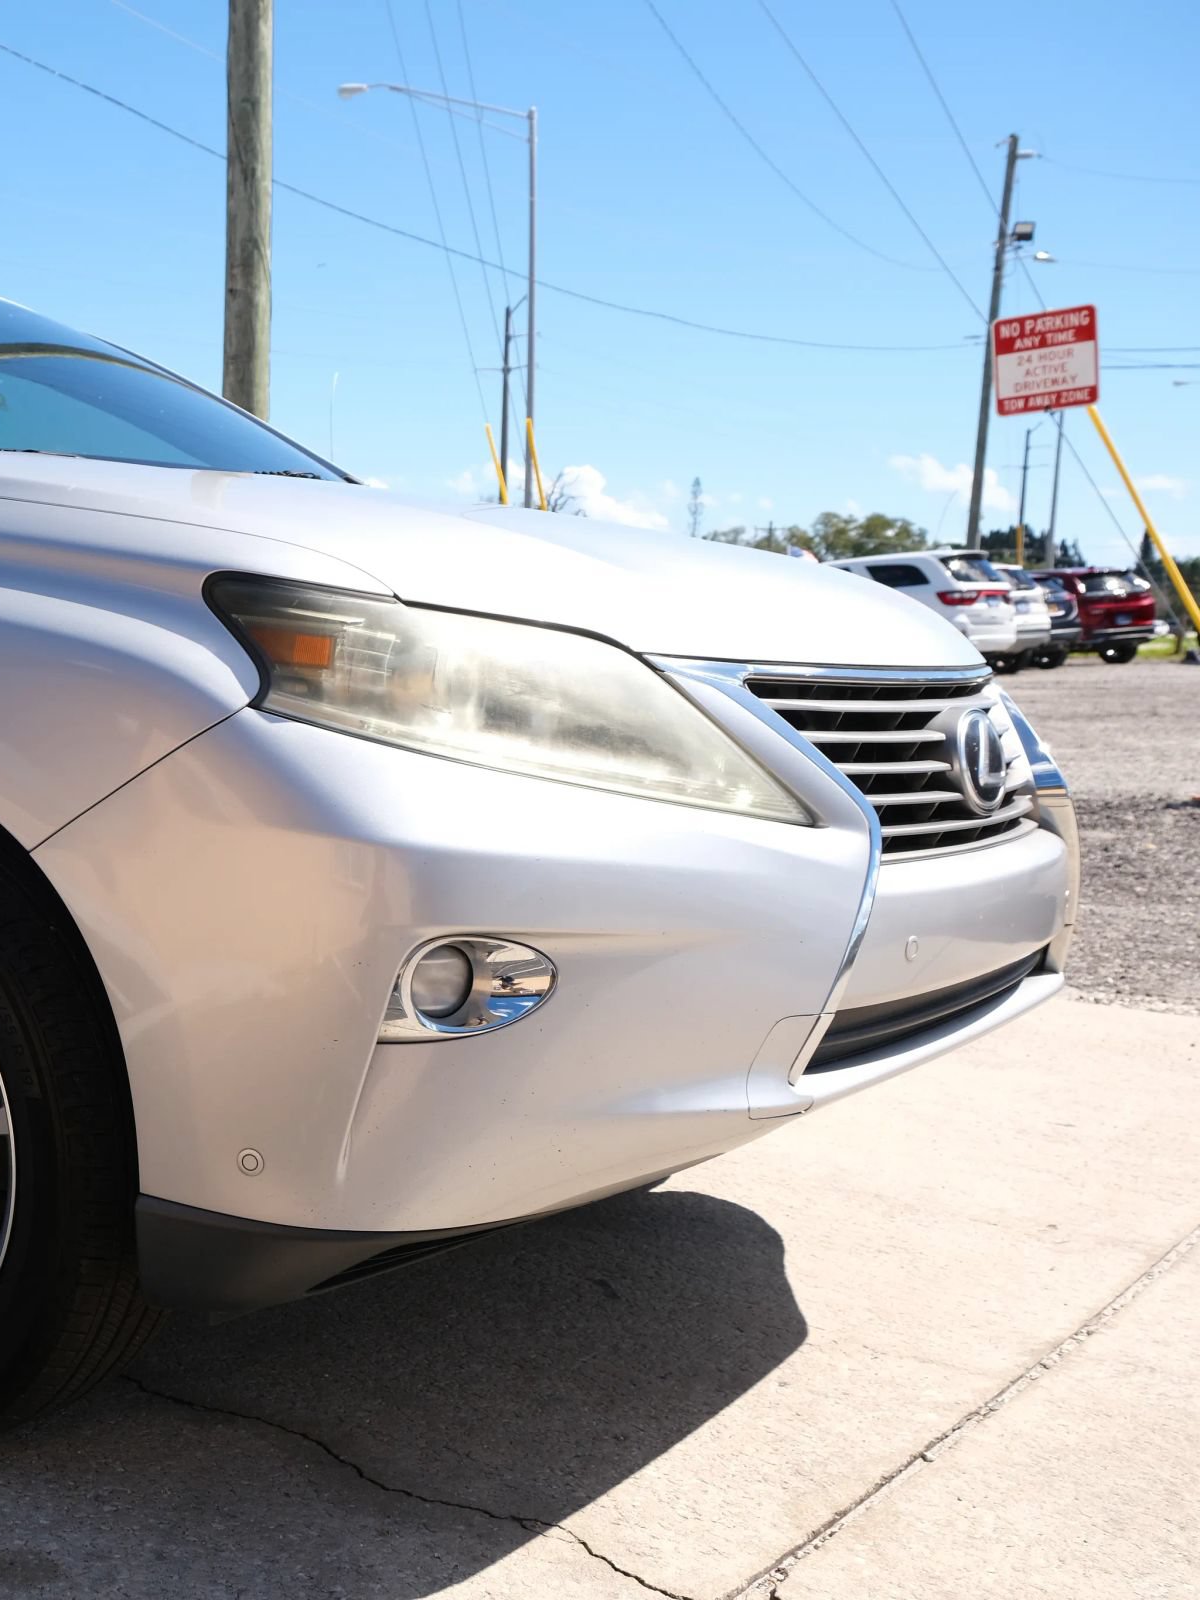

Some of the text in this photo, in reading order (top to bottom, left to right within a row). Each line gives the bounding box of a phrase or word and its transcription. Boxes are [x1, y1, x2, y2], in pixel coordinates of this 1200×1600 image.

[1001, 311, 1090, 339] NO PARKING
[1014, 330, 1077, 350] ANY TIME
[1018, 349, 1074, 366] 24 HOUR
[1026, 362, 1068, 377] ACTIVE
[1015, 375, 1078, 393] DRIVEWAY
[1004, 389, 1091, 411] TOW AWAY ZONE
